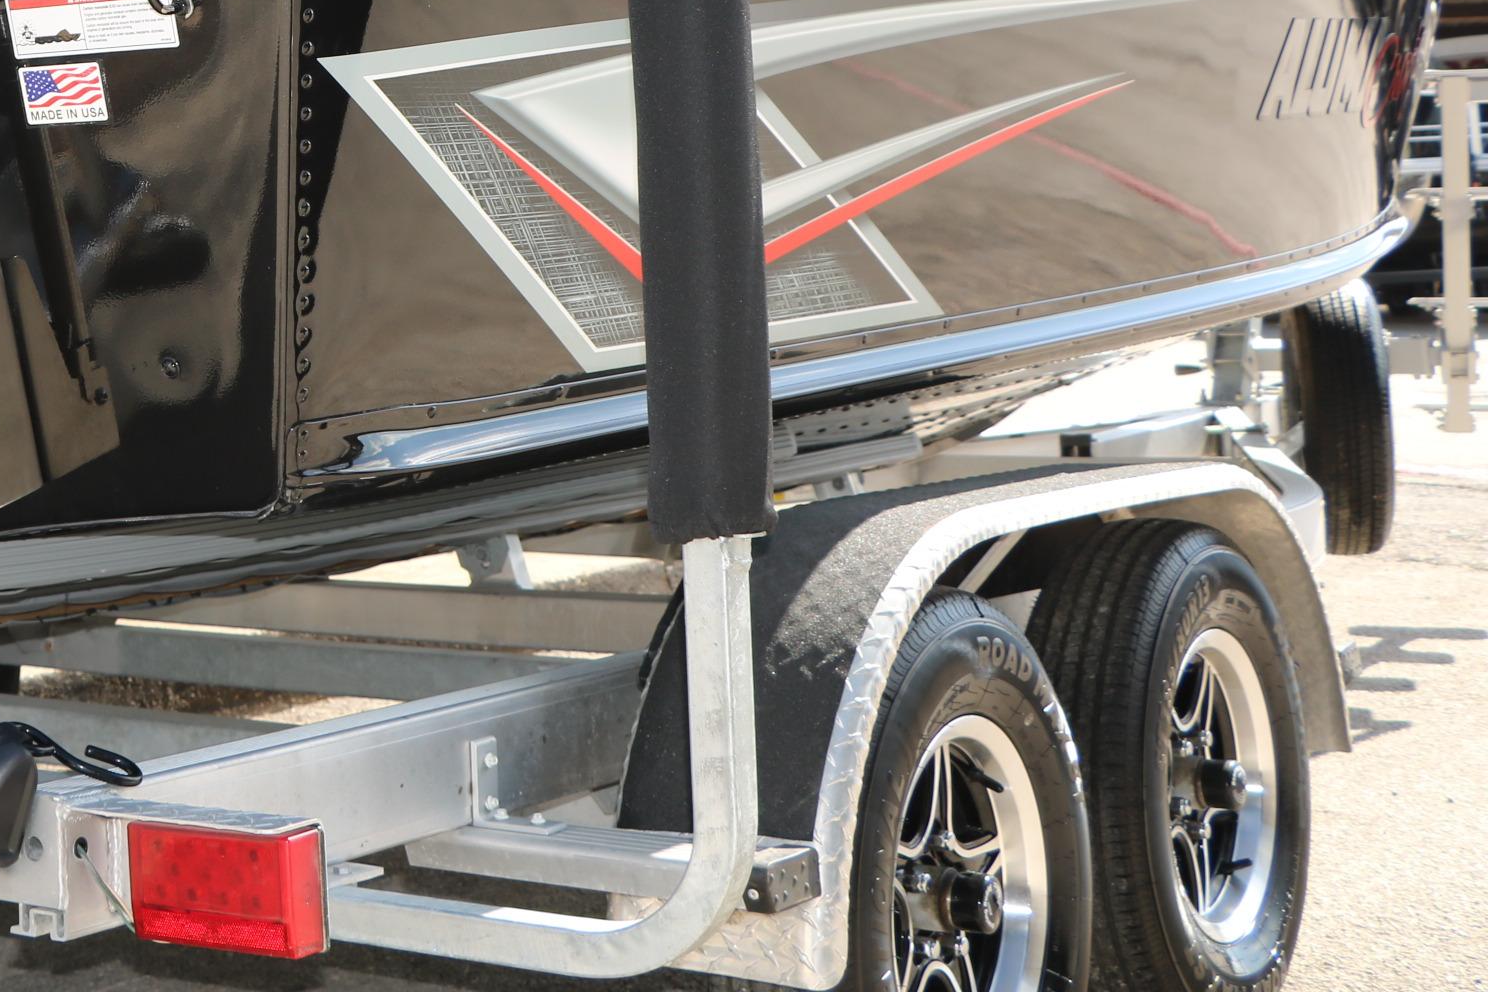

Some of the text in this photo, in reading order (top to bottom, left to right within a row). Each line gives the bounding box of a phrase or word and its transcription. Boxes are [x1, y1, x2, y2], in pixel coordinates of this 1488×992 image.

[31, 107, 105, 121] MADE IN USA
[976, 636, 1033, 683] ROAD
